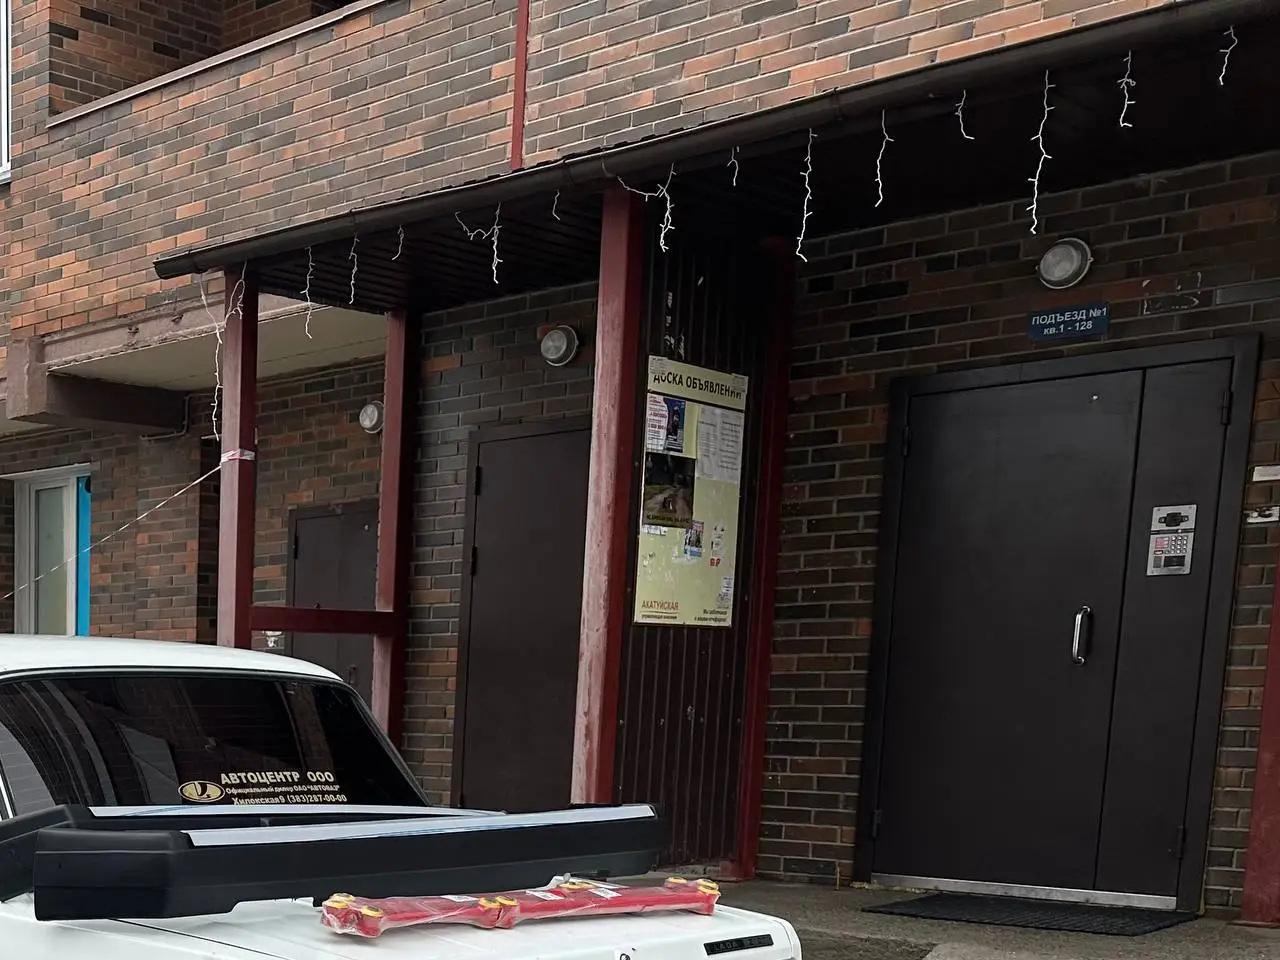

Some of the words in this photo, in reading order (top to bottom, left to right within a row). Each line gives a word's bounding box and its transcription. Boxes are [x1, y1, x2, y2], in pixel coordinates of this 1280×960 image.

[1031, 309, 1087, 326] ПОДЪЕЗД
[1089, 307, 1107, 318] №1
[1074, 320, 1094, 332] 128
[653, 371, 684, 387] ДОСКА
[220, 771, 300, 785] АВТОЦЕНТР
[306, 770, 334, 782] ООО
